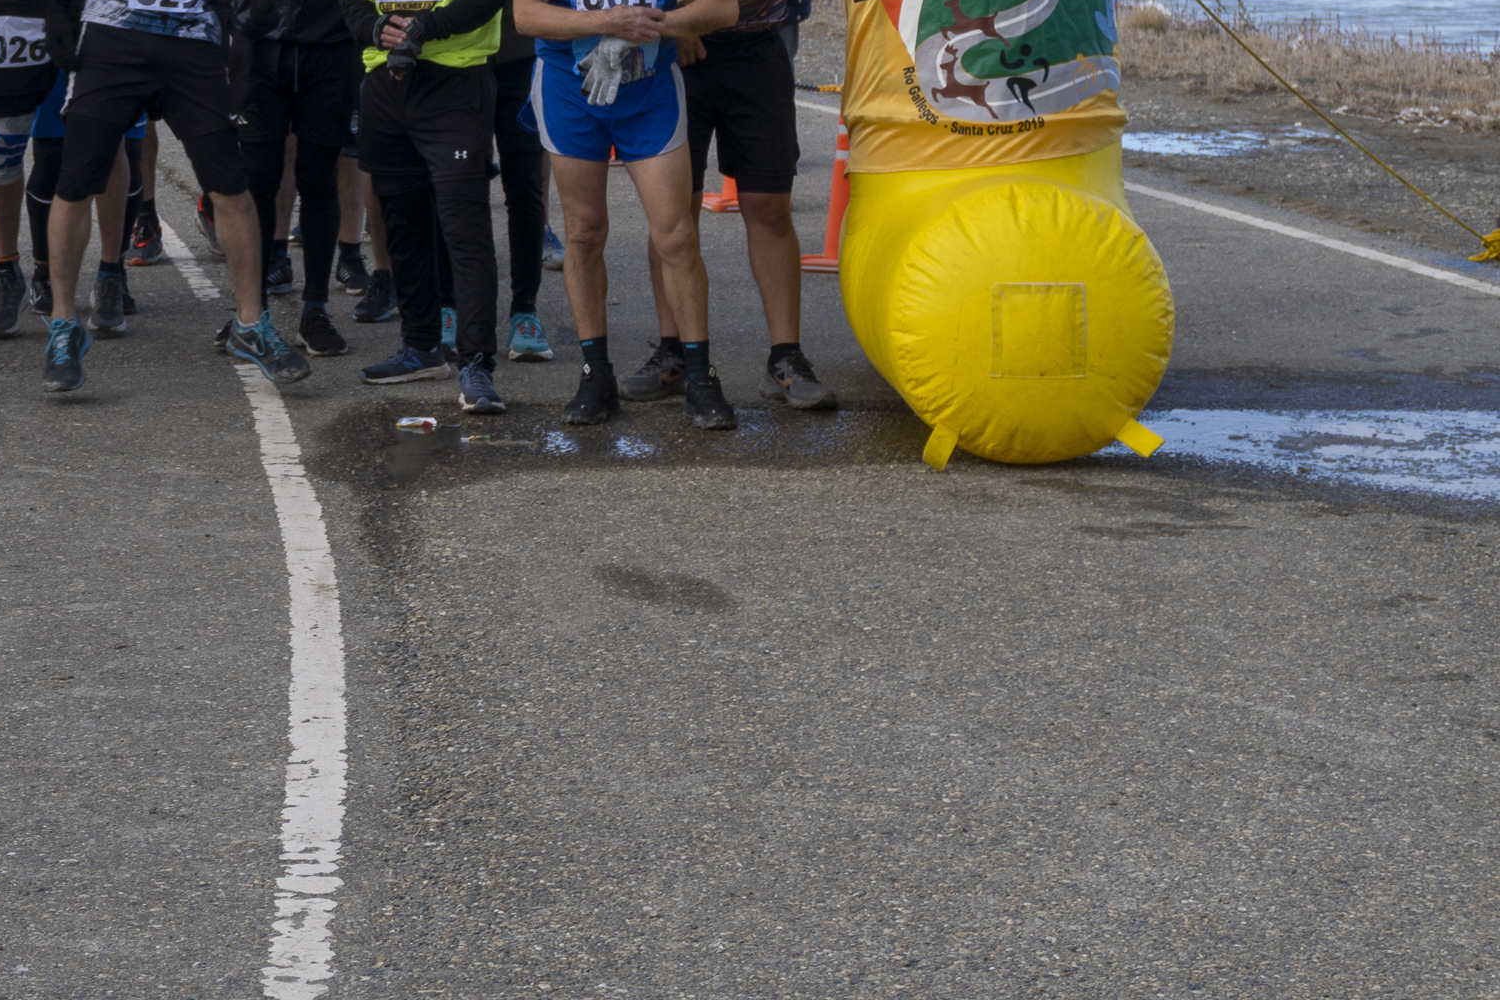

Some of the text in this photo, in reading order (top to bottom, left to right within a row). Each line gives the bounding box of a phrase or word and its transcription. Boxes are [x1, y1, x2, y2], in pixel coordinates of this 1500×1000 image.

[909, 85, 940, 126] Gallegos
[951, 121, 984, 136] Santa
[987, 124, 1014, 136] Cruz
[1017, 116, 1045, 133] 2019
